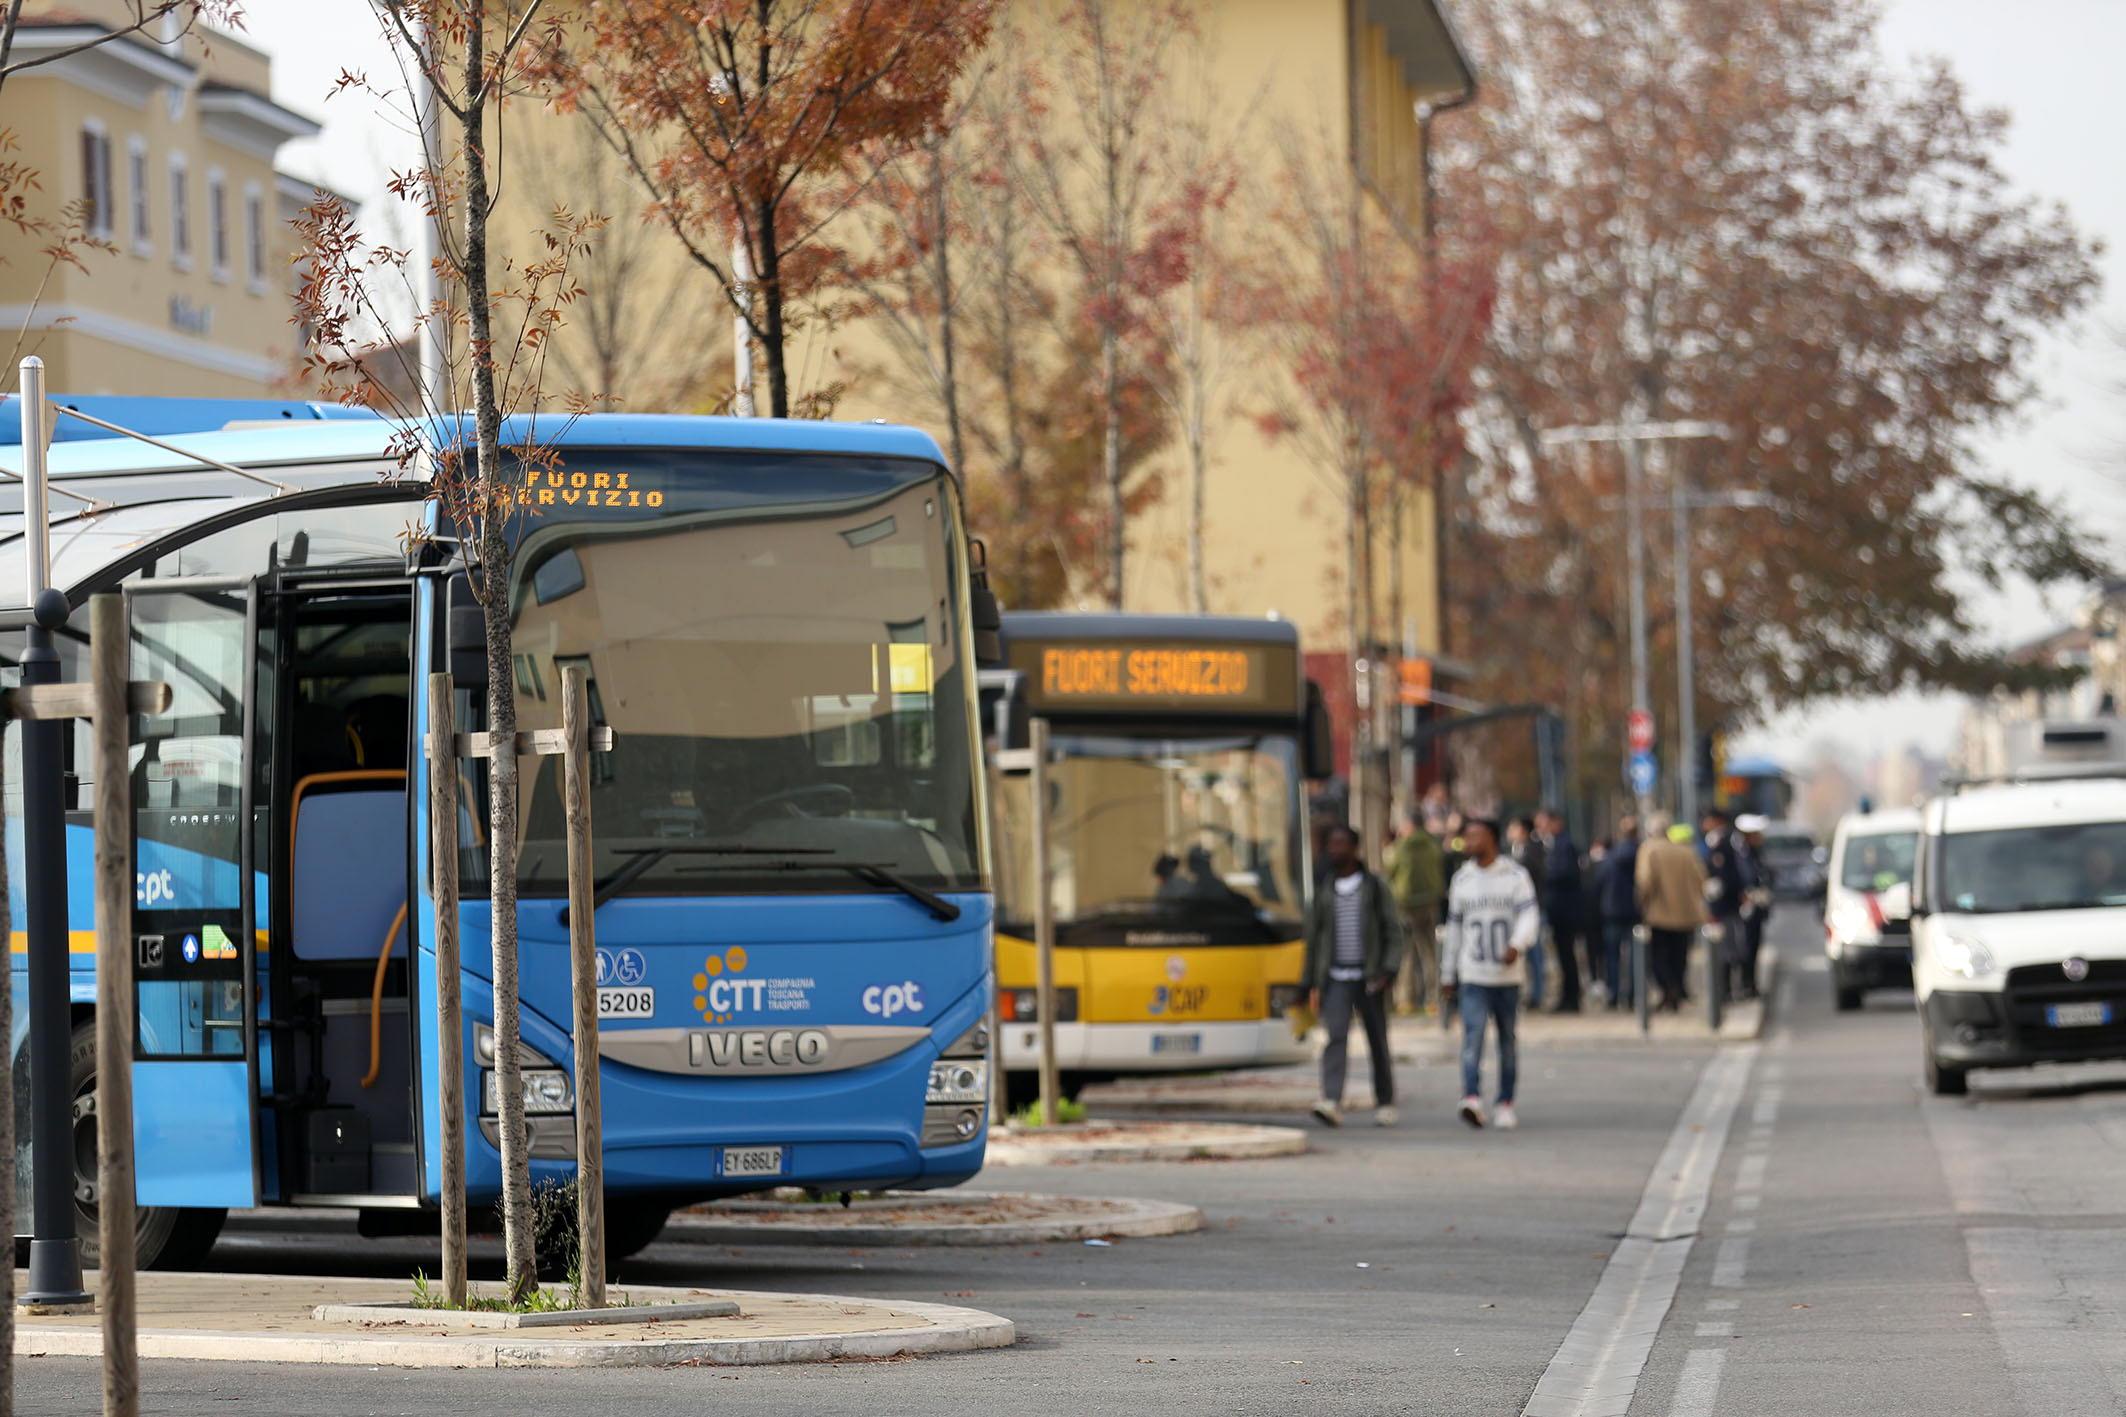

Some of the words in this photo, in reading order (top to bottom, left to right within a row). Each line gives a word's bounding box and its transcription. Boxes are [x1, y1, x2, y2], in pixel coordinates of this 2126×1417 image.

[527, 471, 630, 490] FUORI
[501, 488, 664, 508] ERVIZIO
[1043, 648, 1121, 695] FUORI
[1126, 649, 1249, 695] SERVIZIO
[767, 977, 816, 989] COMPAGNIA
[600, 992, 651, 1012] 5208
[709, 979, 767, 1012] CTT
[768, 989, 805, 999] TOSCANA
[862, 981, 924, 1018] cpt
[688, 1030, 828, 1067] IVECO
